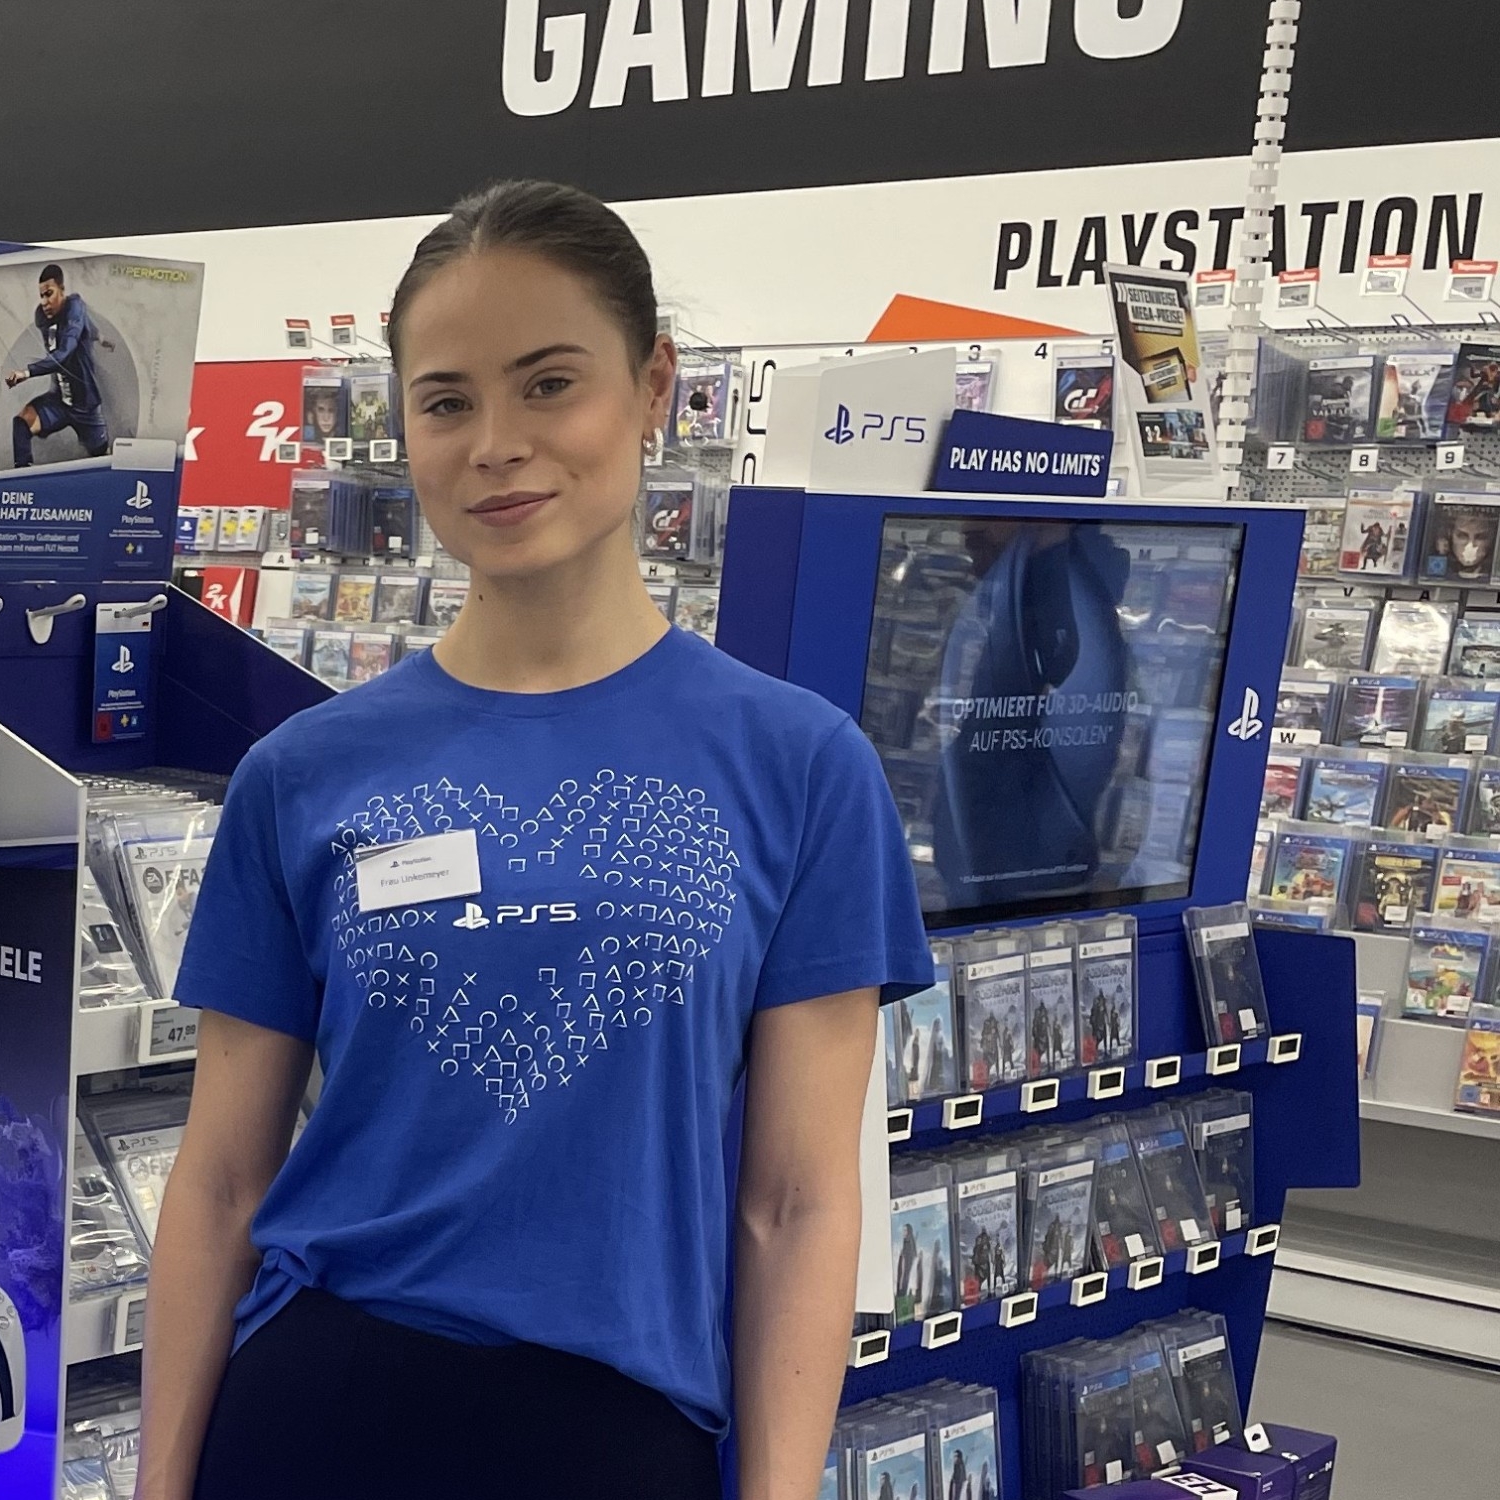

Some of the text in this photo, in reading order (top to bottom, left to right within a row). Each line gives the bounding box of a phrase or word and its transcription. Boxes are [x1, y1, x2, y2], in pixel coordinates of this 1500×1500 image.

[993, 192, 1484, 291] PLAYSTATION
[969, 344, 982, 361] 3
[1034, 342, 1048, 360] 4
[246, 401, 300, 463] 2K
[861, 413, 928, 444] PS5
[949, 447, 1101, 477] PLAY HAS NO LIMITS
[1276, 451, 1287, 465] 7
[1358, 454, 1370, 468] 8
[1444, 451, 1456, 465] 9
[1, 491, 34, 505] DEINE
[29, 507, 93, 522] ZUSAMMEN
[648, 565, 658, 577] H
[205, 583, 228, 610] 2K
[952, 695, 1037, 720] OPTIMIERT
[1069, 691, 1139, 715] 3D-AUDIO
[969, 729, 1000, 753] AUF
[1279, 731, 1296, 744] W
[380, 878, 399, 889] Frau
[497, 903, 578, 924] PS5
[1171, 1474, 1227, 1495] H3
